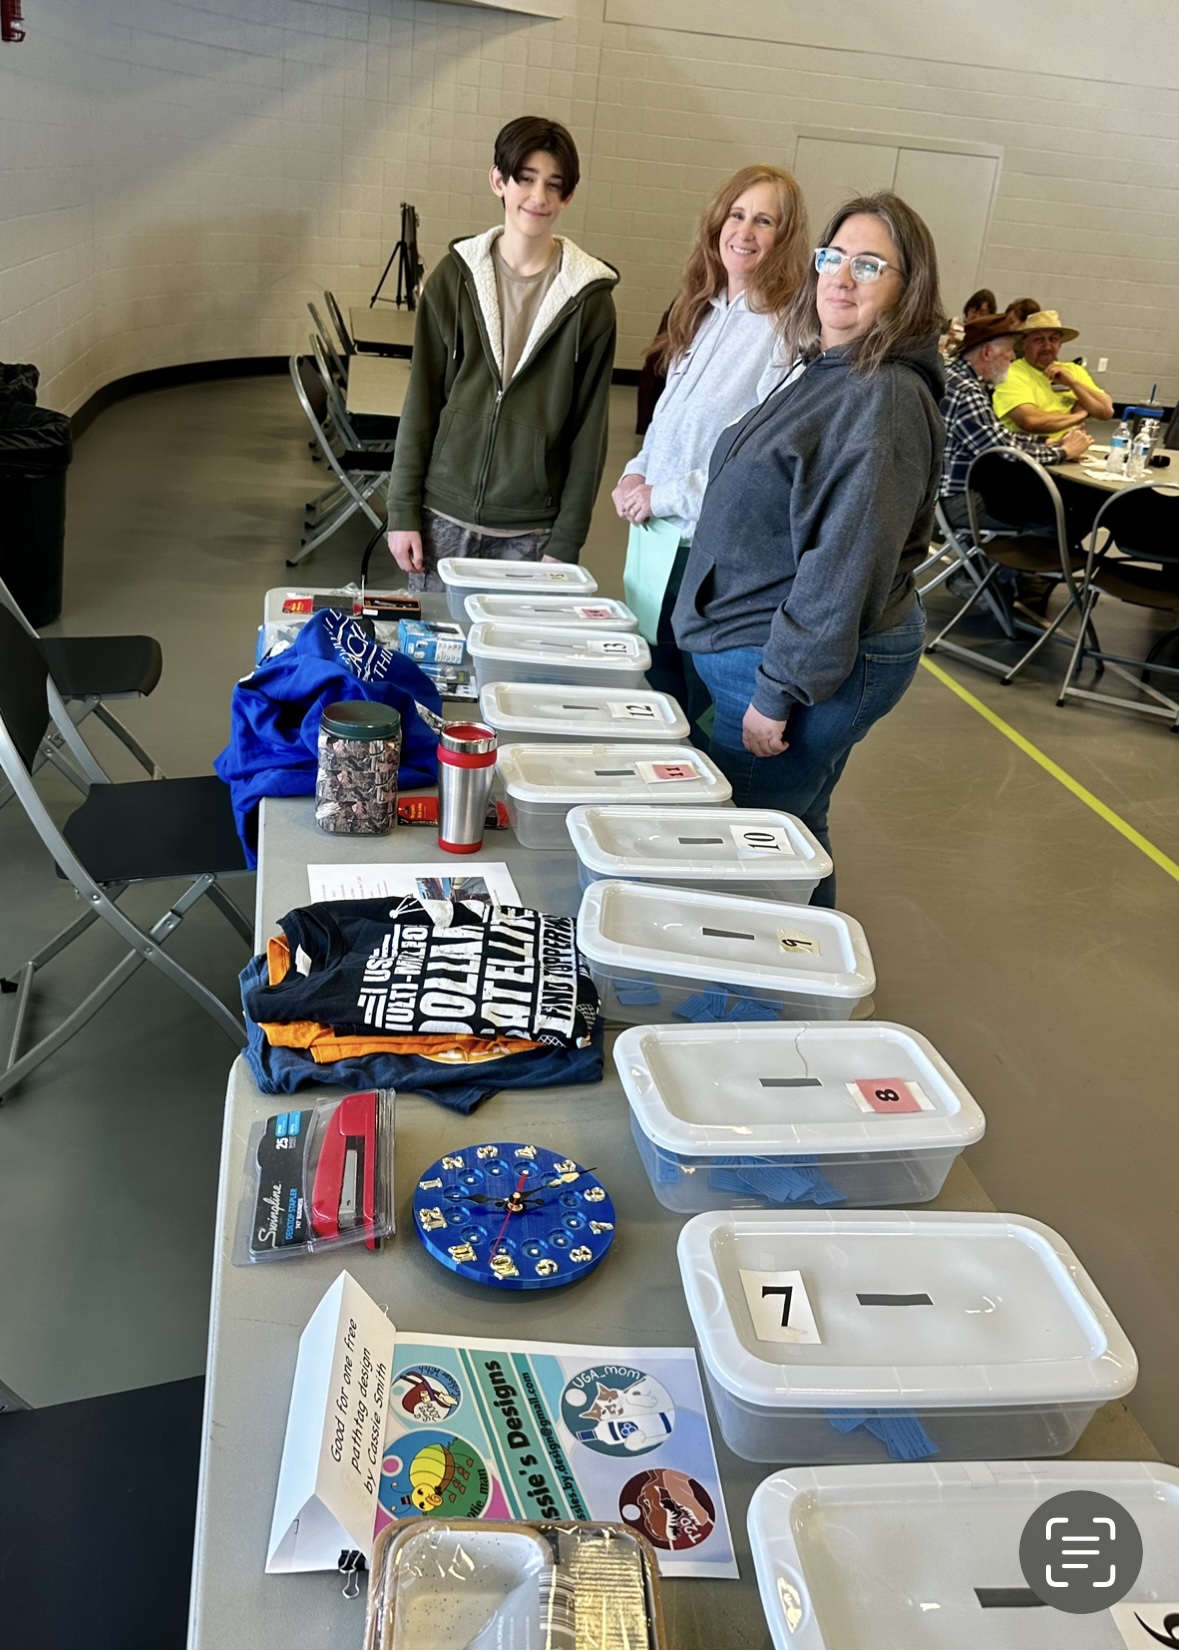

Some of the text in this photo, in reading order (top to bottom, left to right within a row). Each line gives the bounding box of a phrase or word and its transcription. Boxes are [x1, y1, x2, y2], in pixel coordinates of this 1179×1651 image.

[603, 642, 627, 653] 13
[626, 705, 655, 717] 12
[665, 766, 684, 777] 11
[743, 832, 781, 851] 10
[782, 939, 813, 947] 9
[540, 981, 573, 1019] FIND
[875, 1088, 900, 1102] 8
[276, 1137, 289, 1149] 25
[476, 1145, 498, 1159] 3
[514, 1144, 539, 1160] 4
[441, 1155, 465, 1170] 2
[553, 1159, 577, 1173] 5
[419, 1177, 443, 1190] 1
[258, 1183, 285, 1249] Swingline
[286, 1188, 298, 1240] DESKTOP STAPLER
[419, 1207, 448, 1232] 12
[588, 1220, 614, 1235] 7
[448, 1242, 478, 1264] 11
[569, 1245, 593, 1263] 8
[489, 1254, 520, 1280] 10
[761, 1285, 793, 1327] 7
[331, 1318, 357, 1463] Good for one free
[351, 1347, 373, 1475] pathtag design
[485, 1360, 531, 1449] Designs
[364, 1362, 387, 1495] by Cassie Smith
[522, 1372, 587, 1521] ssies.by.design@gmail.com
[519, 1454, 562, 1520] ssie's
[680, 1517, 702, 1544] T2D
